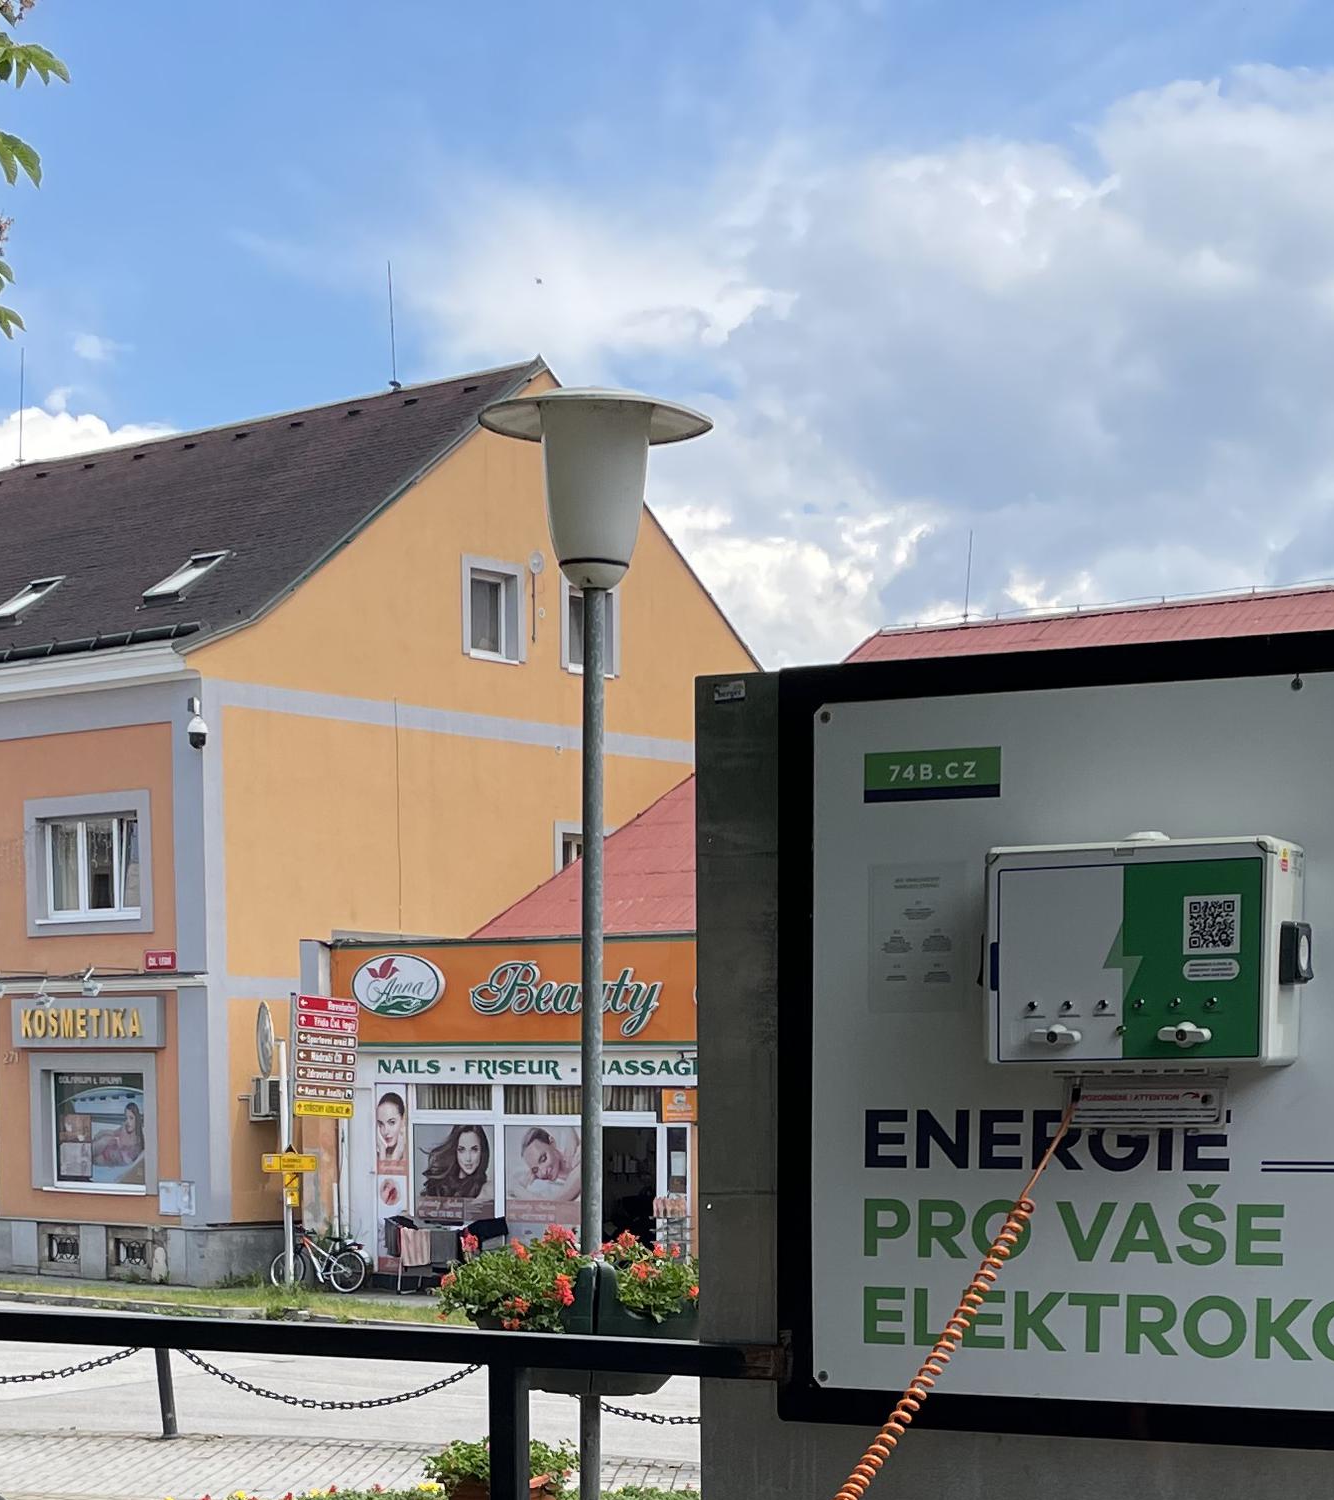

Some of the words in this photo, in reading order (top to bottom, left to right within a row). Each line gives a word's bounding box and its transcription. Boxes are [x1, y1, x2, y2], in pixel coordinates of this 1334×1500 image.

[889, 761, 977, 782] 74B.CZ
[367, 977, 433, 1003] Anna
[21, 1007, 142, 1039] KOSMETIKA
[378, 1059, 441, 1075] NAILS
[464, 1059, 563, 1080] FRISEUR
[864, 1109, 1232, 1172] ENERGIE
[863, 1198, 1032, 1260] PRO
[1055, 1183, 1286, 1267] VAŠE
